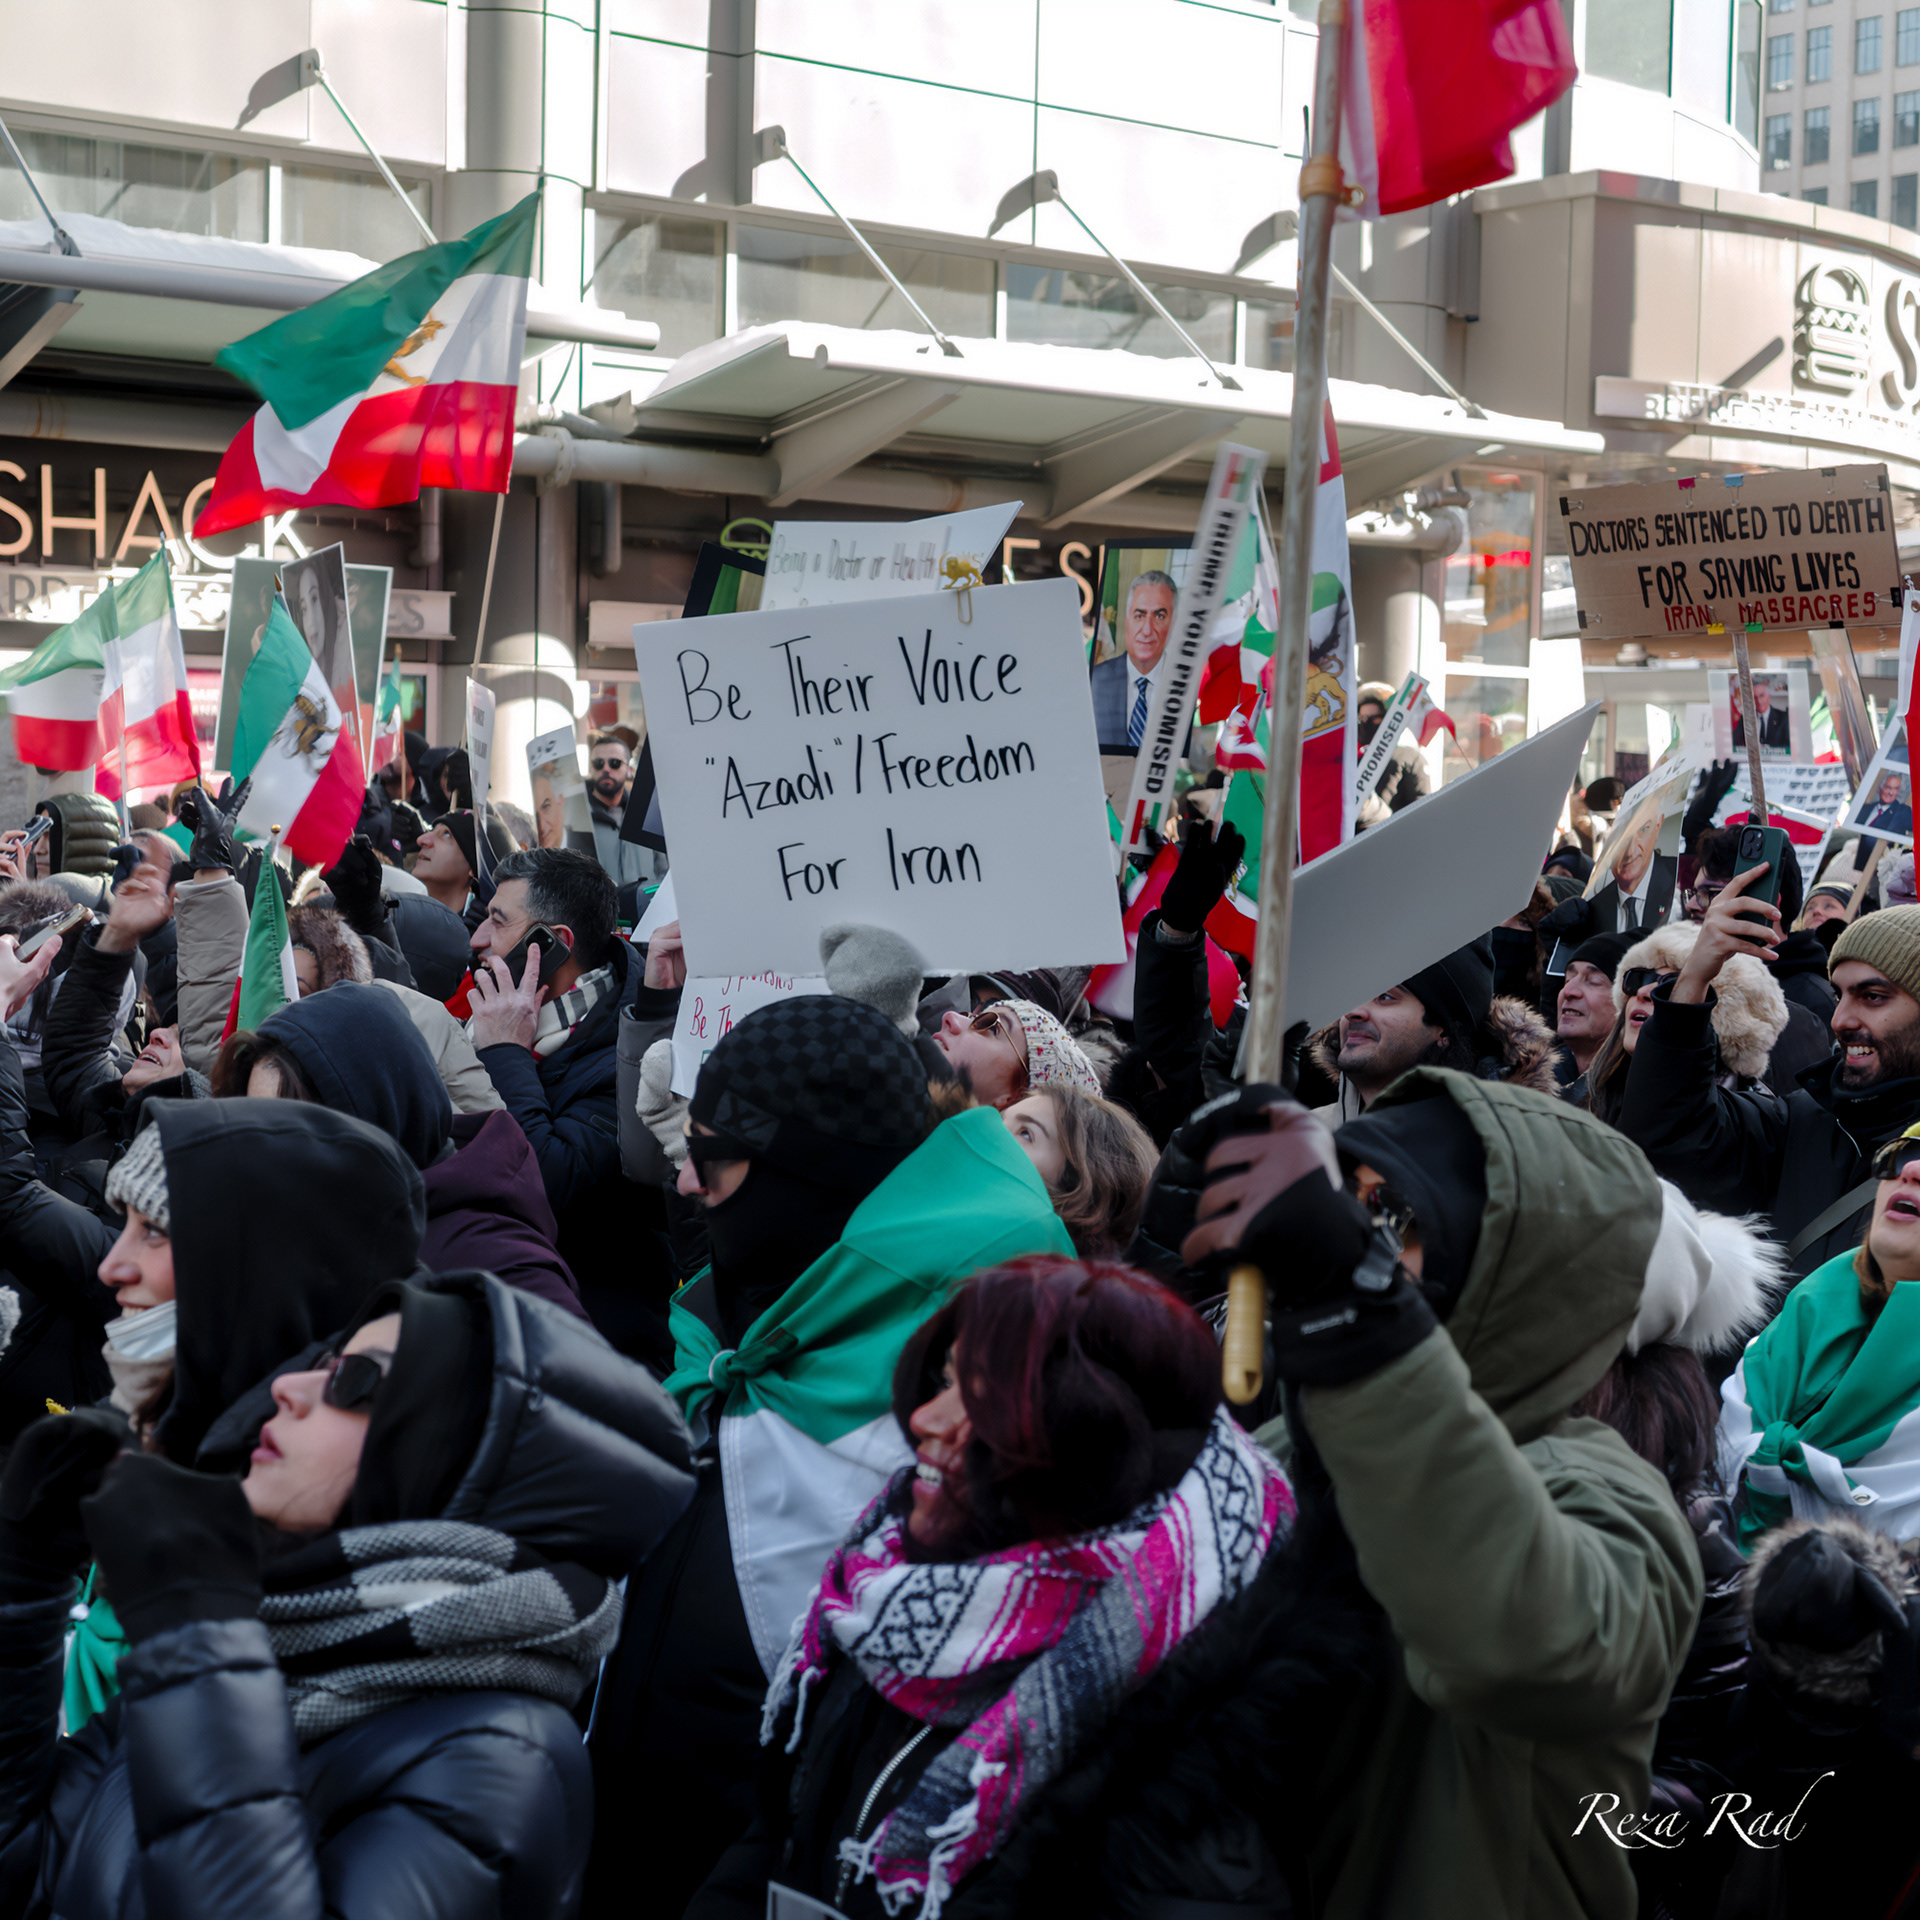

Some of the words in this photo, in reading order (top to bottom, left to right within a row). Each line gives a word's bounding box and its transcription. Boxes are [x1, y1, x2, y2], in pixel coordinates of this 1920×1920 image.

[1569, 517, 1649, 557] DOCTORS
[1655, 506, 1767, 547] SENTENCED
[1773, 503, 1801, 536] TO
[1808, 497, 1886, 534] DEATH
[1637, 561, 1694, 609] FOR
[1699, 554, 1786, 600] SAVING
[1791, 551, 1861, 593] LIVES
[1664, 604, 1712, 632] IRAN
[1738, 591, 1876, 624] MASSACRES
[677, 649, 751, 726] Be
[769, 635, 874, 717] Their
[897, 628, 1022, 706] Voice
[1145, 662, 1194, 795] PROMISED
[1356, 710, 1405, 793] PROMISED
[777, 843, 847, 901] For
[886, 827, 982, 891] Iran
[689, 996, 708, 1040] Be
